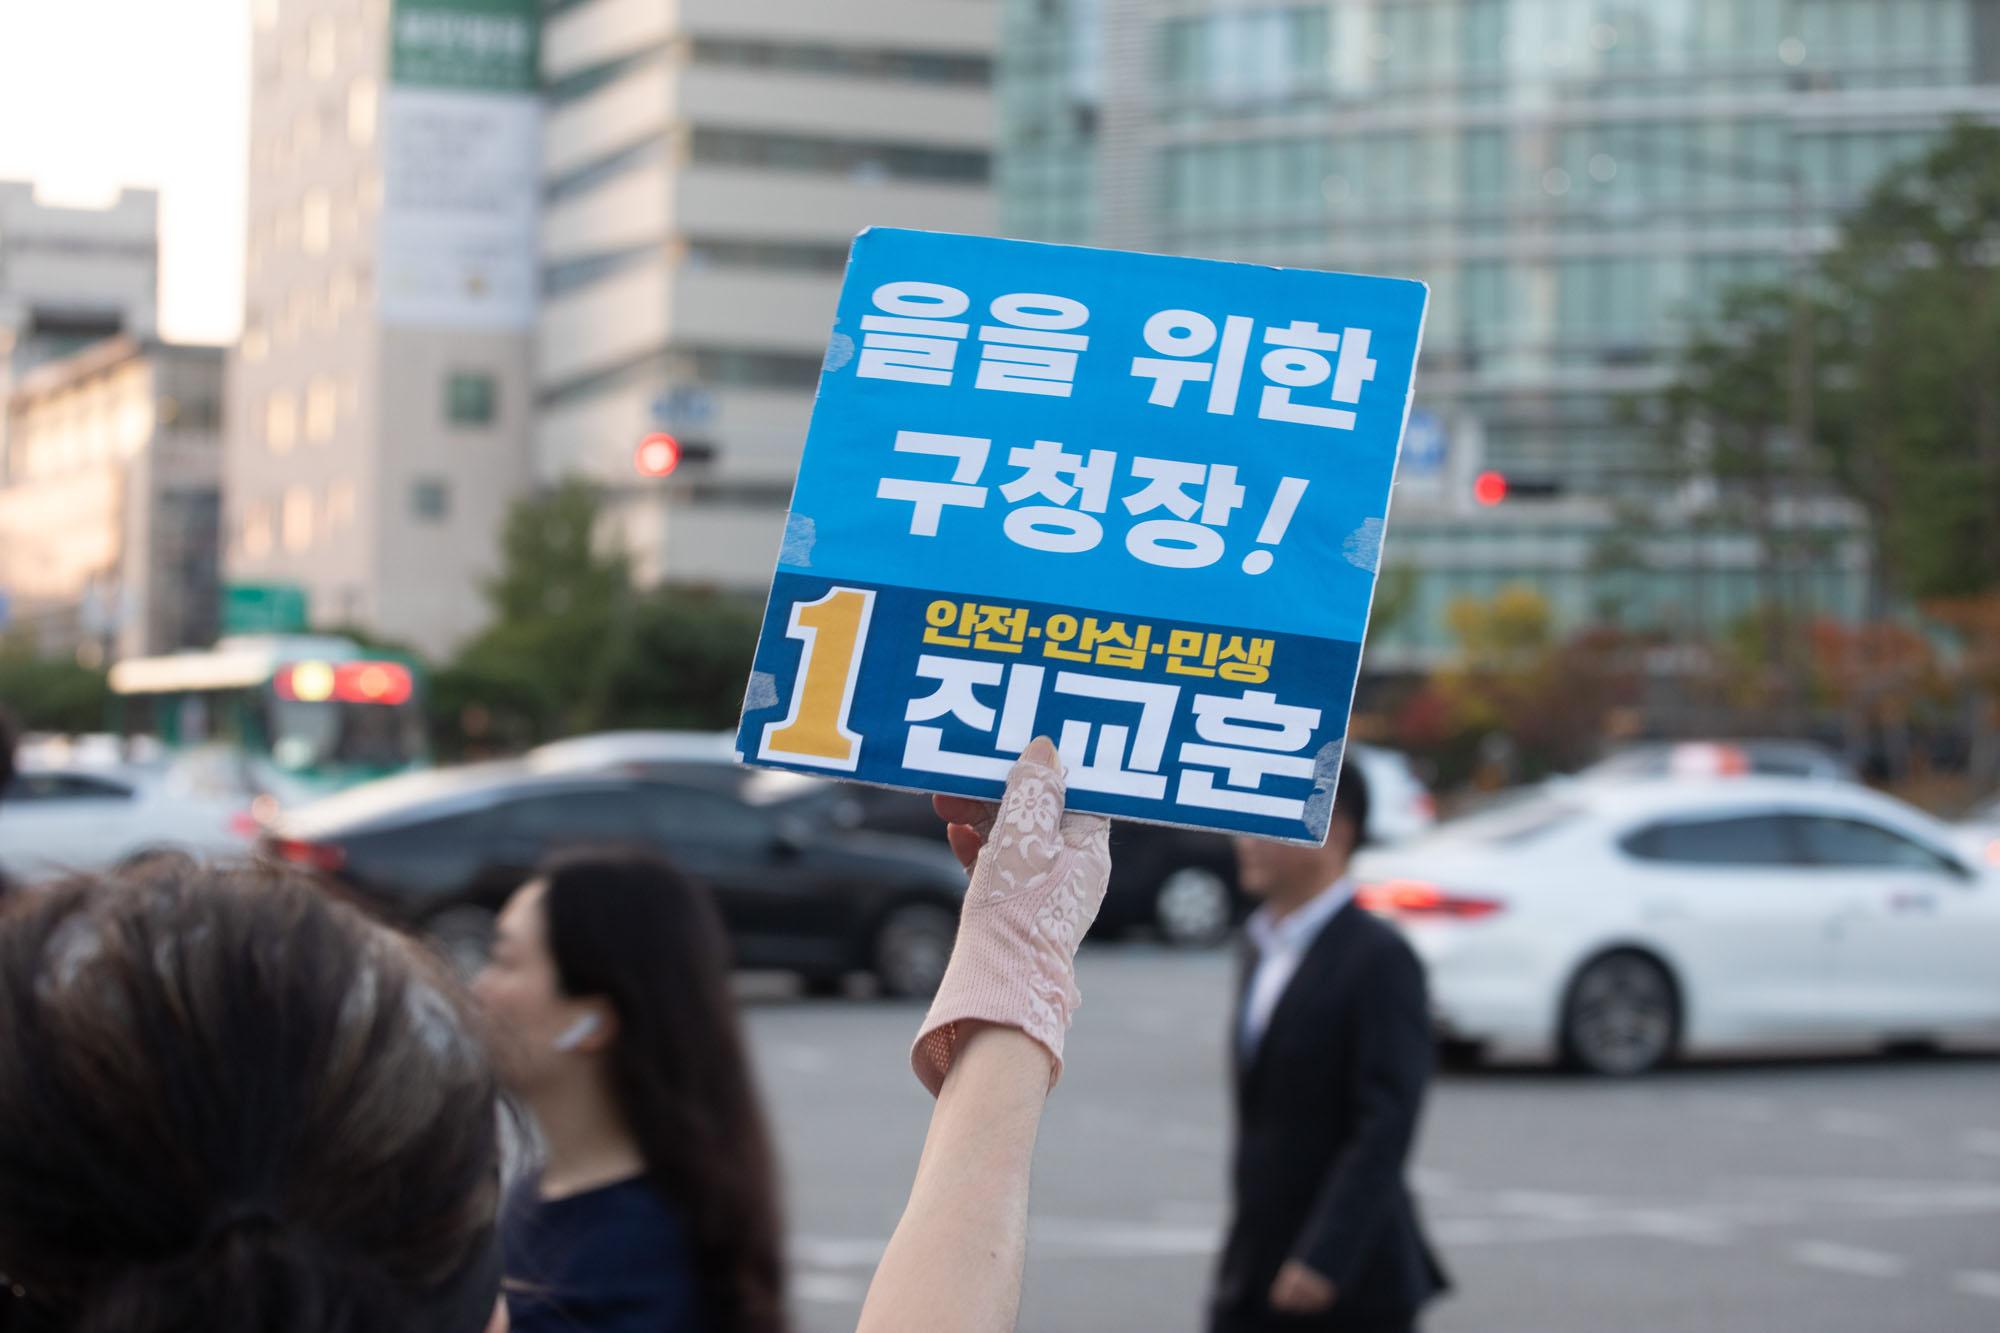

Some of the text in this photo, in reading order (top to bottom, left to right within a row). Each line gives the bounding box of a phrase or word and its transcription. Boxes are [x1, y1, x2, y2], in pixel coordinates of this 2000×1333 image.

[855, 280, 1378, 431] 을을 위한
[875, 430, 1311, 576] 구청장!
[757, 586, 877, 772] 1
[901, 654, 1323, 820] 진교훈
